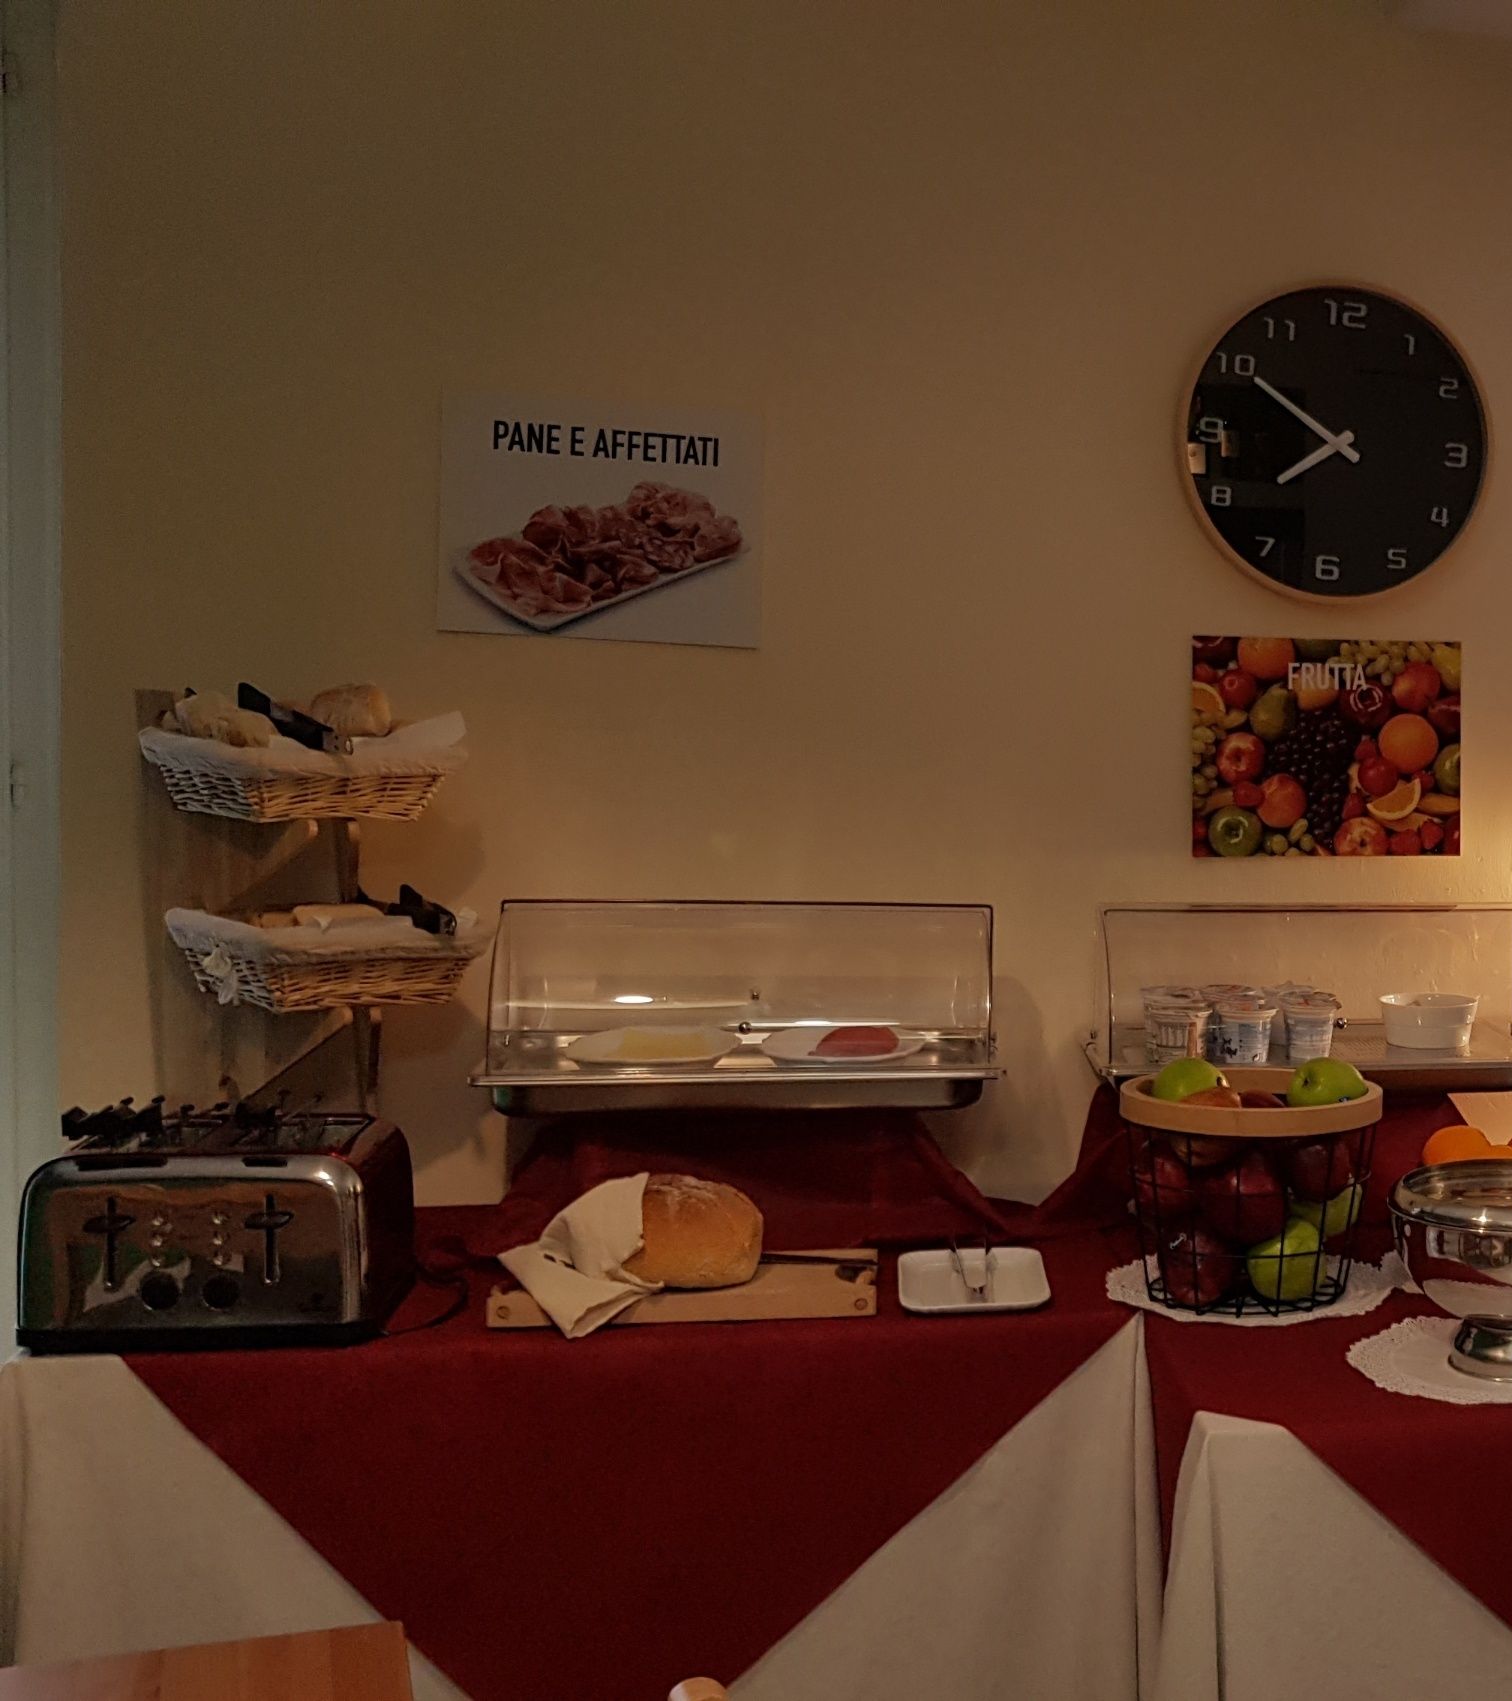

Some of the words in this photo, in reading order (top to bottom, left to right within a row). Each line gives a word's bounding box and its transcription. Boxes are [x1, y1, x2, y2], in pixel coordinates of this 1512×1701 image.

[1323, 298, 1368, 329] 12
[1263, 317, 1296, 342] 11
[1404, 334, 1415, 356] 1
[1216, 351, 1256, 377] 10
[1439, 377, 1459, 399] 2
[1199, 416, 1223, 444] 9
[493, 420, 562, 455] PANE
[569, 426, 585, 457] E
[591, 428, 720, 467] AFFETTATI
[1444, 442, 1468, 469] 3
[1210, 486, 1232, 507] 8
[1430, 506, 1450, 528] 4
[1255, 536, 1276, 557] 7
[1386, 548, 1407, 570] 5
[1315, 556, 1341, 581] 6
[1288, 662, 1368, 691] FRUTTA
